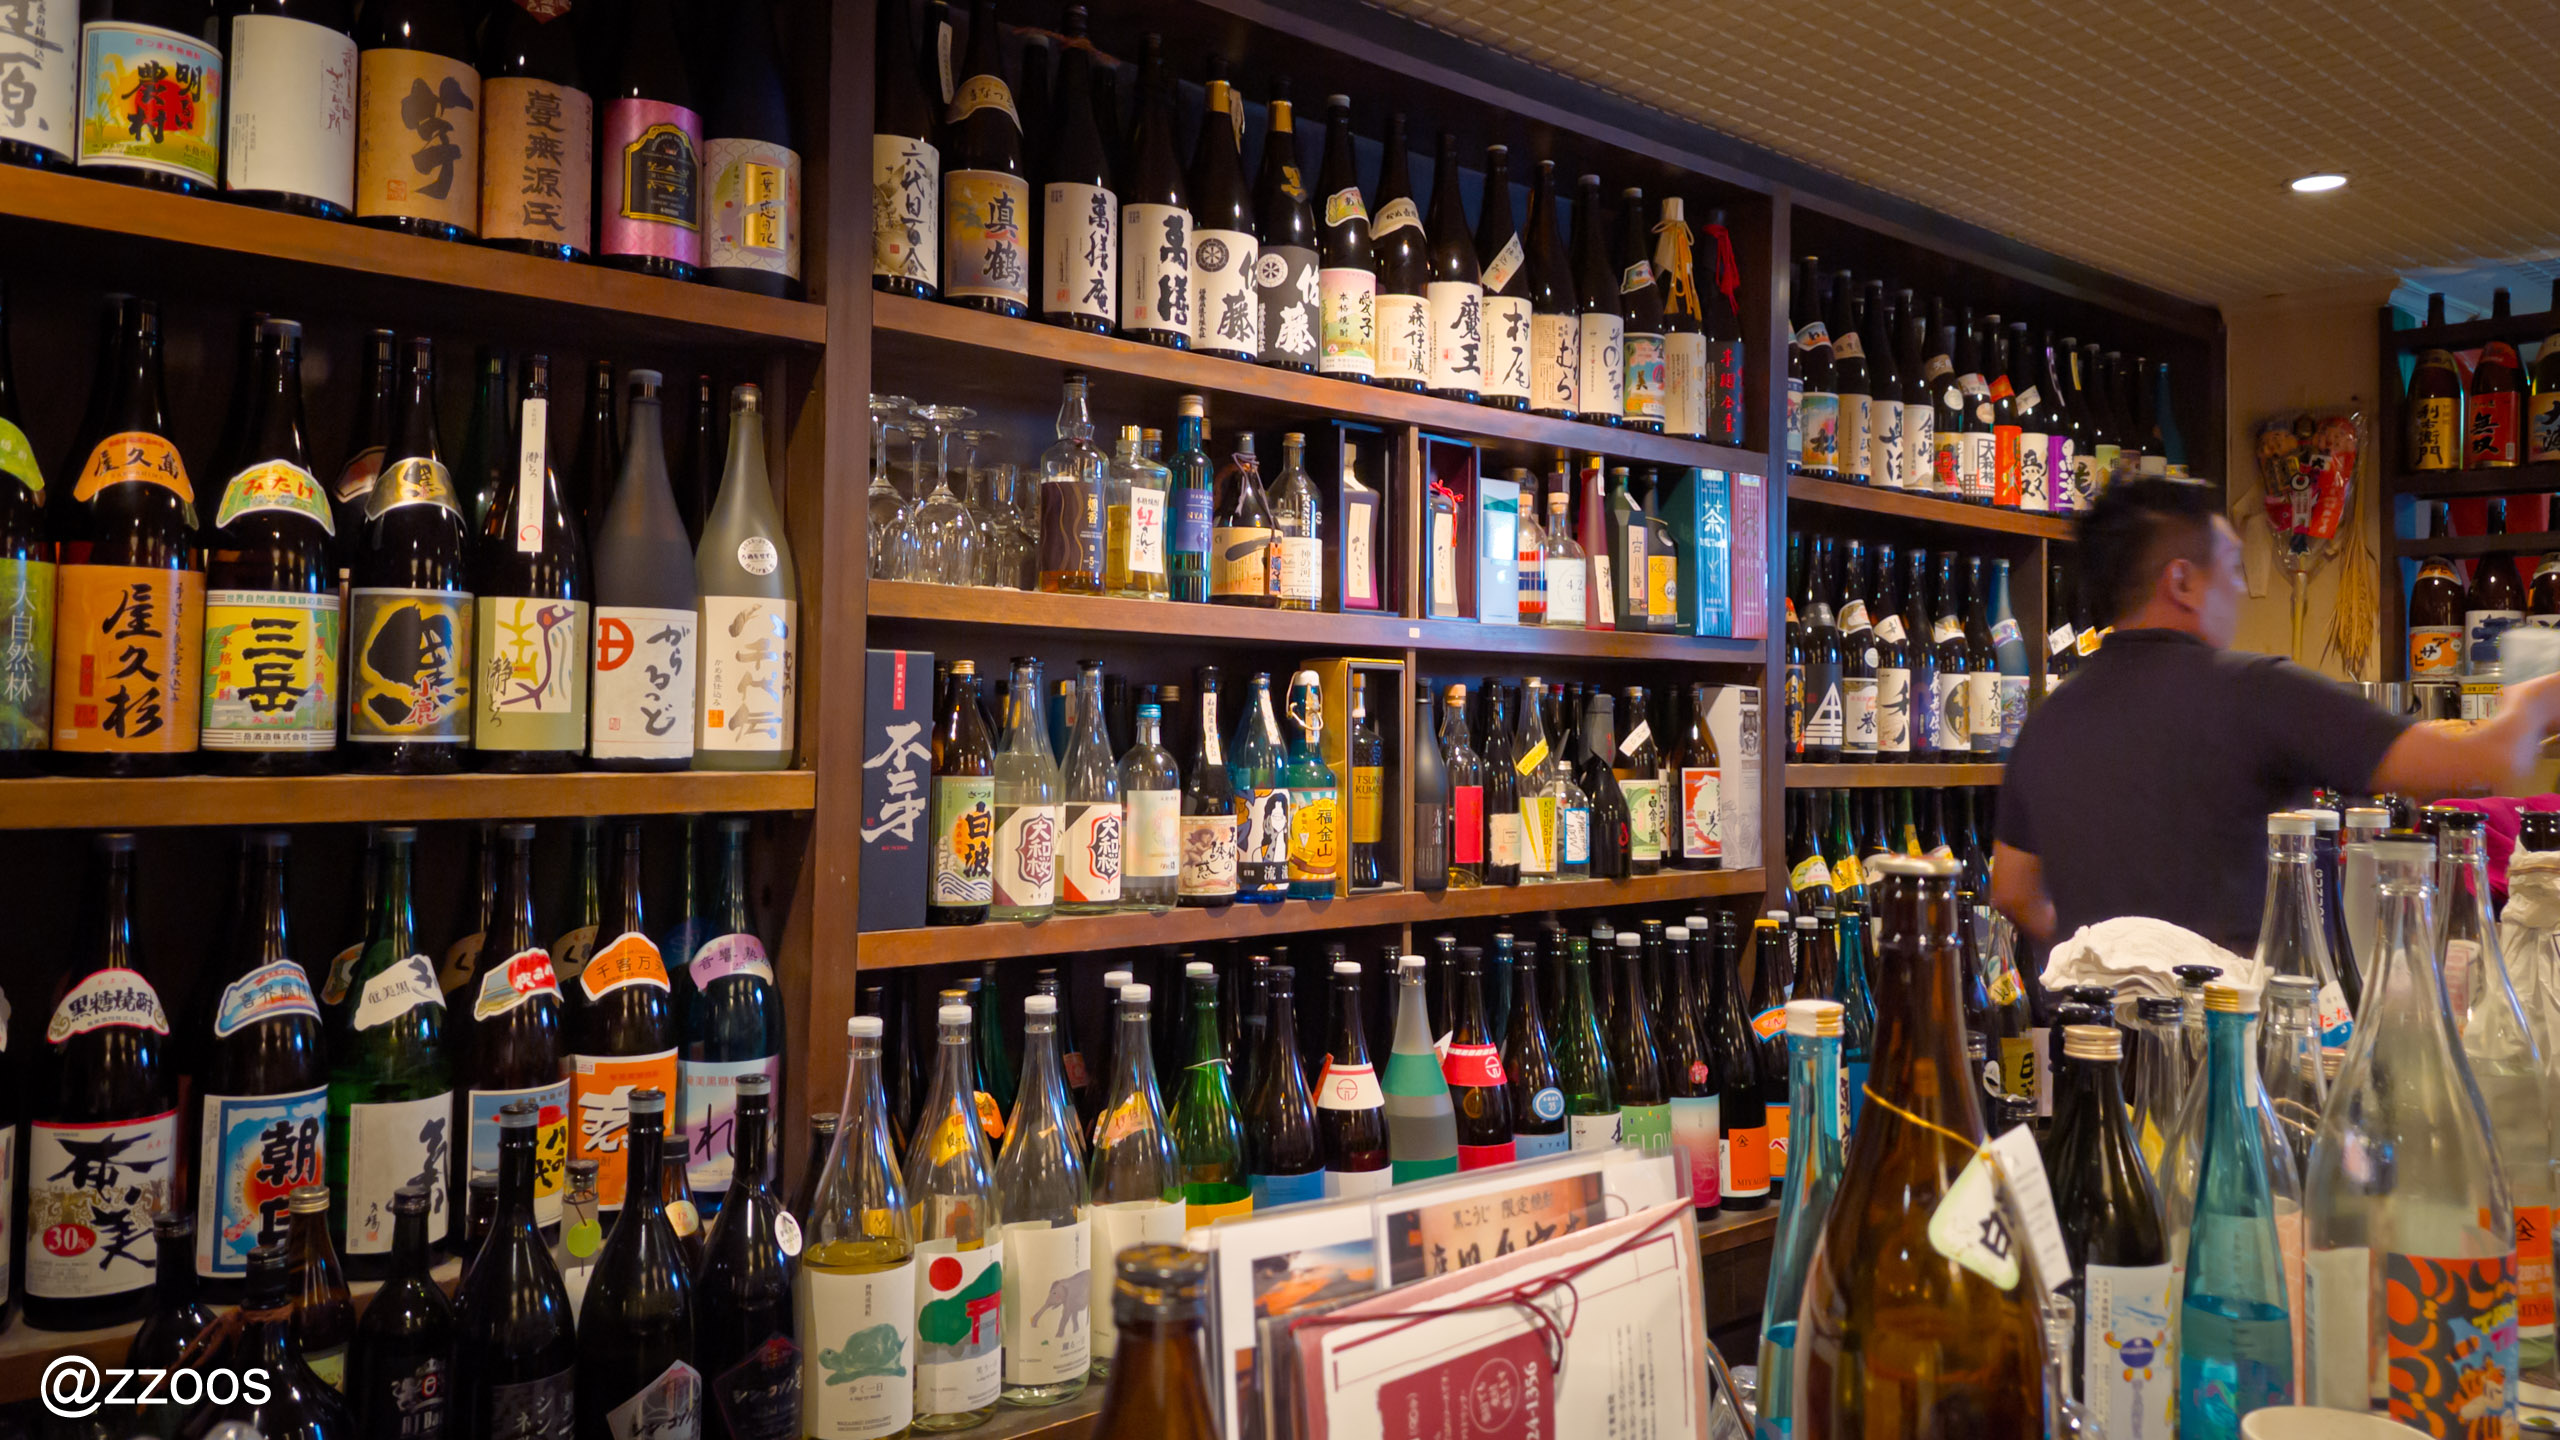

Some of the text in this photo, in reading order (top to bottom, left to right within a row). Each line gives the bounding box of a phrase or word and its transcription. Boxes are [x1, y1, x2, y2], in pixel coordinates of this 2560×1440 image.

[121, 59, 169, 144] 農村
[401, 76, 474, 200] 芋
[900, 142, 927, 277] 六代目百合
[983, 191, 1022, 287] 真鶴
[1082, 193, 1110, 315] 萬膳庵
[1157, 214, 1190, 326] 萬膳
[1274, 263, 1319, 356] 佐藤
[1358, 289, 1374, 338] 愛子
[1403, 301, 1428, 376] 森伊蔵
[1450, 294, 1481, 375] 魔王
[1502, 301, 1531, 390] 村尾
[1603, 327, 1621, 400] そのまま
[94, 447, 179, 480] 屋久島
[2416, 403, 2444, 466] 利右衛門
[2470, 411, 2501, 454] 無双
[242, 475, 316, 501] みたけ
[1701, 499, 1726, 535] 茶
[4, 580, 37, 702] 大自然林
[102, 583, 164, 739] 屋久杉
[237, 617, 309, 714] 三岳
[728, 602, 789, 744] 八千代伝
[2414, 636, 2450, 667] アサヒ
[405, 676, 441, 726] 小鹿
[640, 623, 691, 737] がらるっど
[860, 720, 932, 843] 不二才
[963, 800, 992, 879] 白波
[1026, 820, 1052, 879] 大和桜
[1095, 817, 1120, 877] 大和桜
[1315, 808, 1335, 858] 福金山
[69, 987, 154, 1018] 黒糖焼酎
[46, 1132, 170, 1271] 奄美
[48, 1225, 90, 1252] 30%
[1453, 1204, 1490, 1230] 黒こうじ
[849, 1382, 884, 1394] 歩く一日
